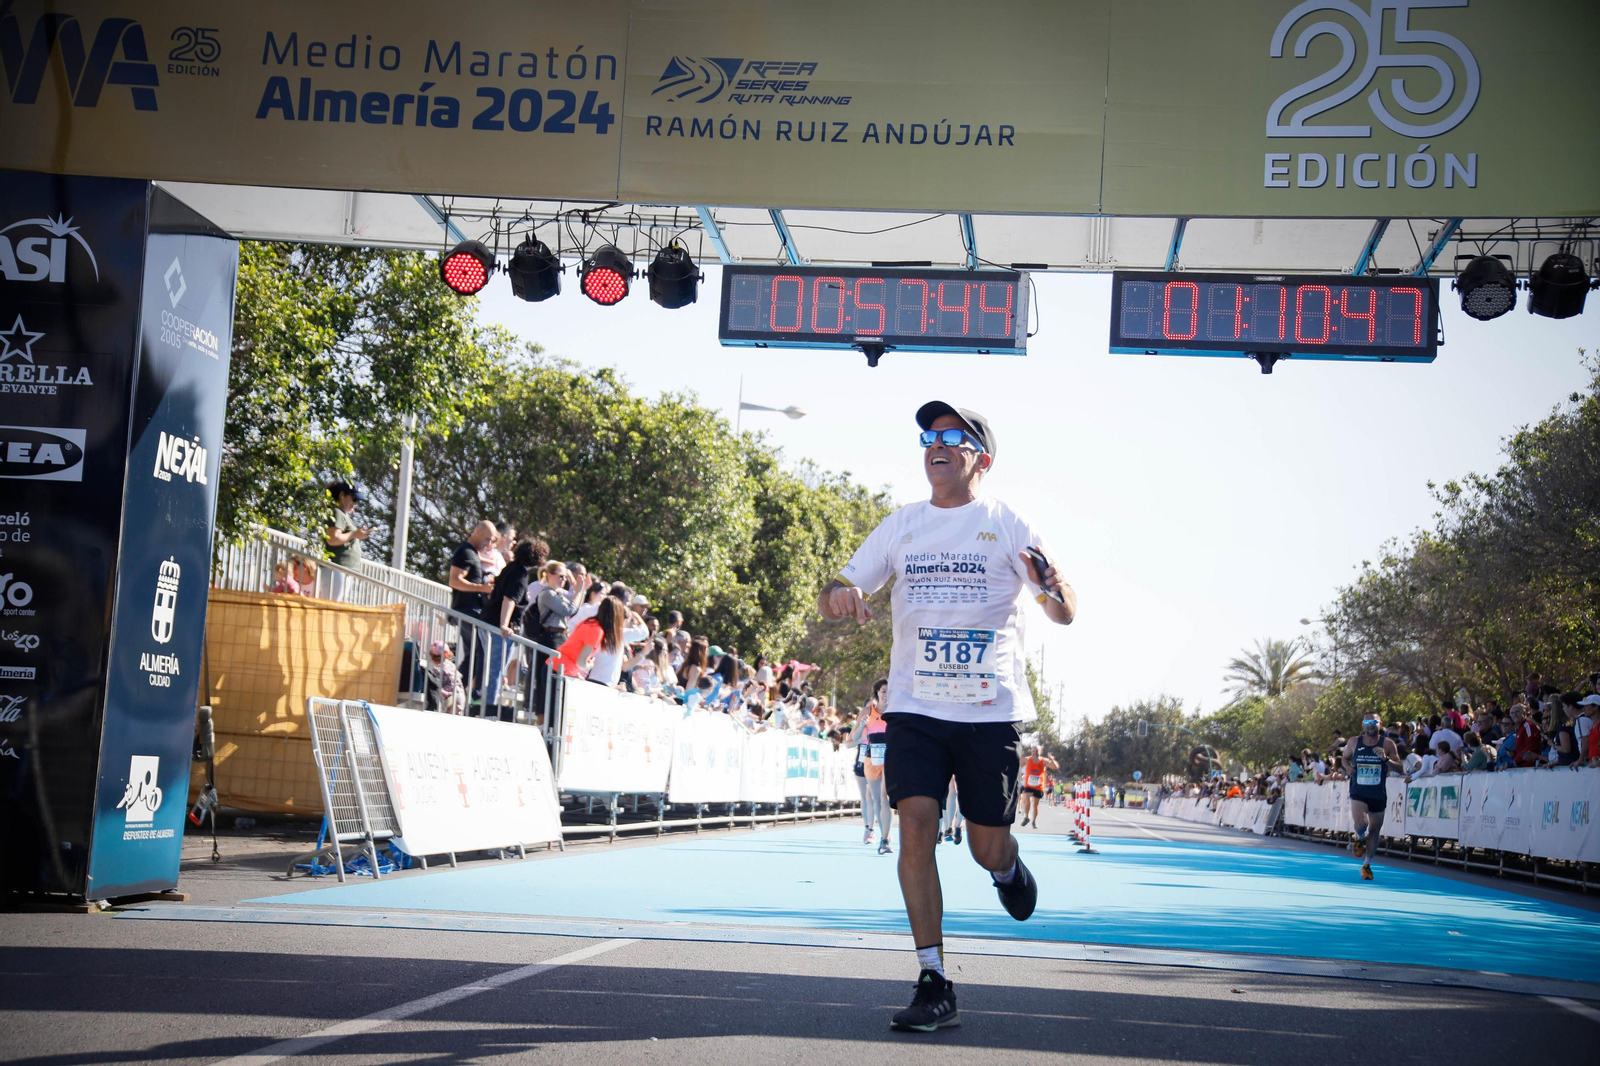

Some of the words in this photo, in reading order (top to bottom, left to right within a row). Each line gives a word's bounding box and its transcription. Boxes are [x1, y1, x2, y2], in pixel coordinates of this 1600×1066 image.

[168, 26, 221, 63] 25
[262, 31, 401, 71] Medio
[424, 40, 617, 80] Maratón
[167, 63, 220, 77] EDICIÓN
[743, 60, 818, 78] RFEA
[1266, 0, 1481, 138] 25
[734, 79, 810, 93] SERIES
[255, 76, 460, 129] Almería
[472, 87, 615, 135] 2024
[727, 93, 775, 105] RUTA
[779, 95, 852, 106] RUNNING
[646, 113, 760, 140] RAMÓN
[776, 120, 849, 143] RUIZ
[862, 119, 1016, 147] ANDÚJAR
[1264, 143, 1478, 189] EDICIÓN
[161, 309, 218, 351] COOPERACIÓN
[161, 327, 181, 349] 2005
[0, 384, 57, 395] EVANTE
[0, 441, 66, 465] EA
[12, 528, 30, 542] de
[905, 553, 936, 562] Medio
[941, 552, 987, 562] Maratón
[905, 562, 950, 575] Almería
[952, 562, 986, 574] 2024
[953, 576, 987, 584] ANDÚJAR
[3, 608, 18, 616] sport
[924, 641, 987, 664] 5187
[140, 652, 180, 675] ALMERÍA
[149, 674, 170, 687] CIUDAD
[1360, 767, 1379, 775] 1712
